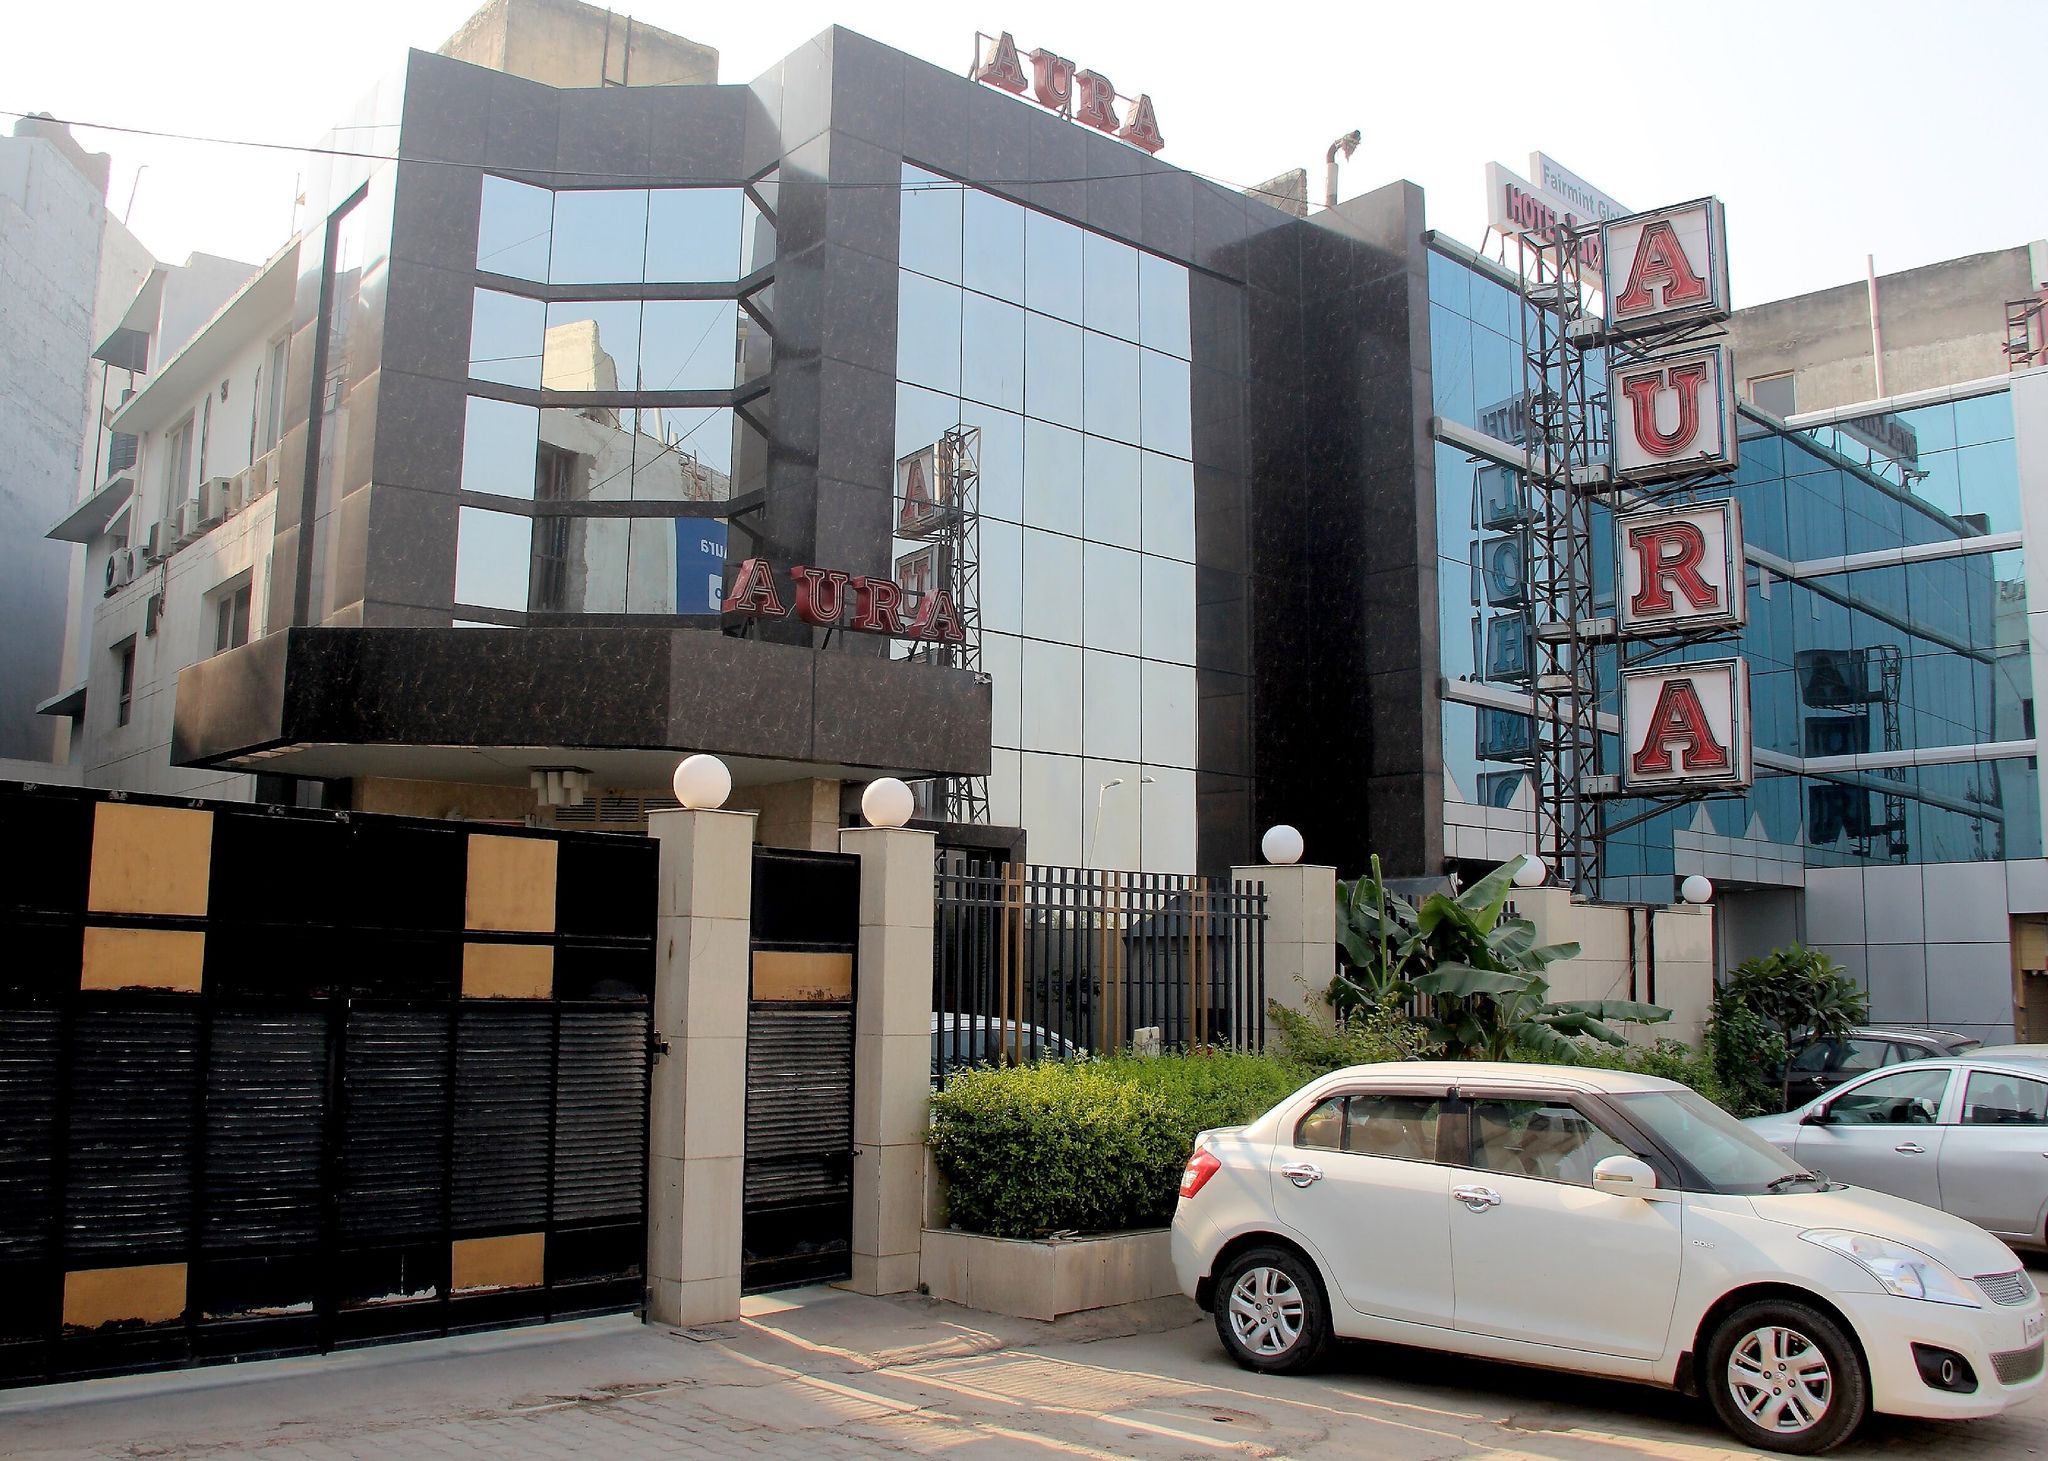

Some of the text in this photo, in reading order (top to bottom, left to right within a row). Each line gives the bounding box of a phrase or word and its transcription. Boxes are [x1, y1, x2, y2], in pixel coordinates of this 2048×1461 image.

[978, 31, 1165, 153] AURA
[1543, 164, 1621, 220] Fairmint Gl
[1616, 220, 1728, 775] AURA
[722, 558, 966, 645] AURA
